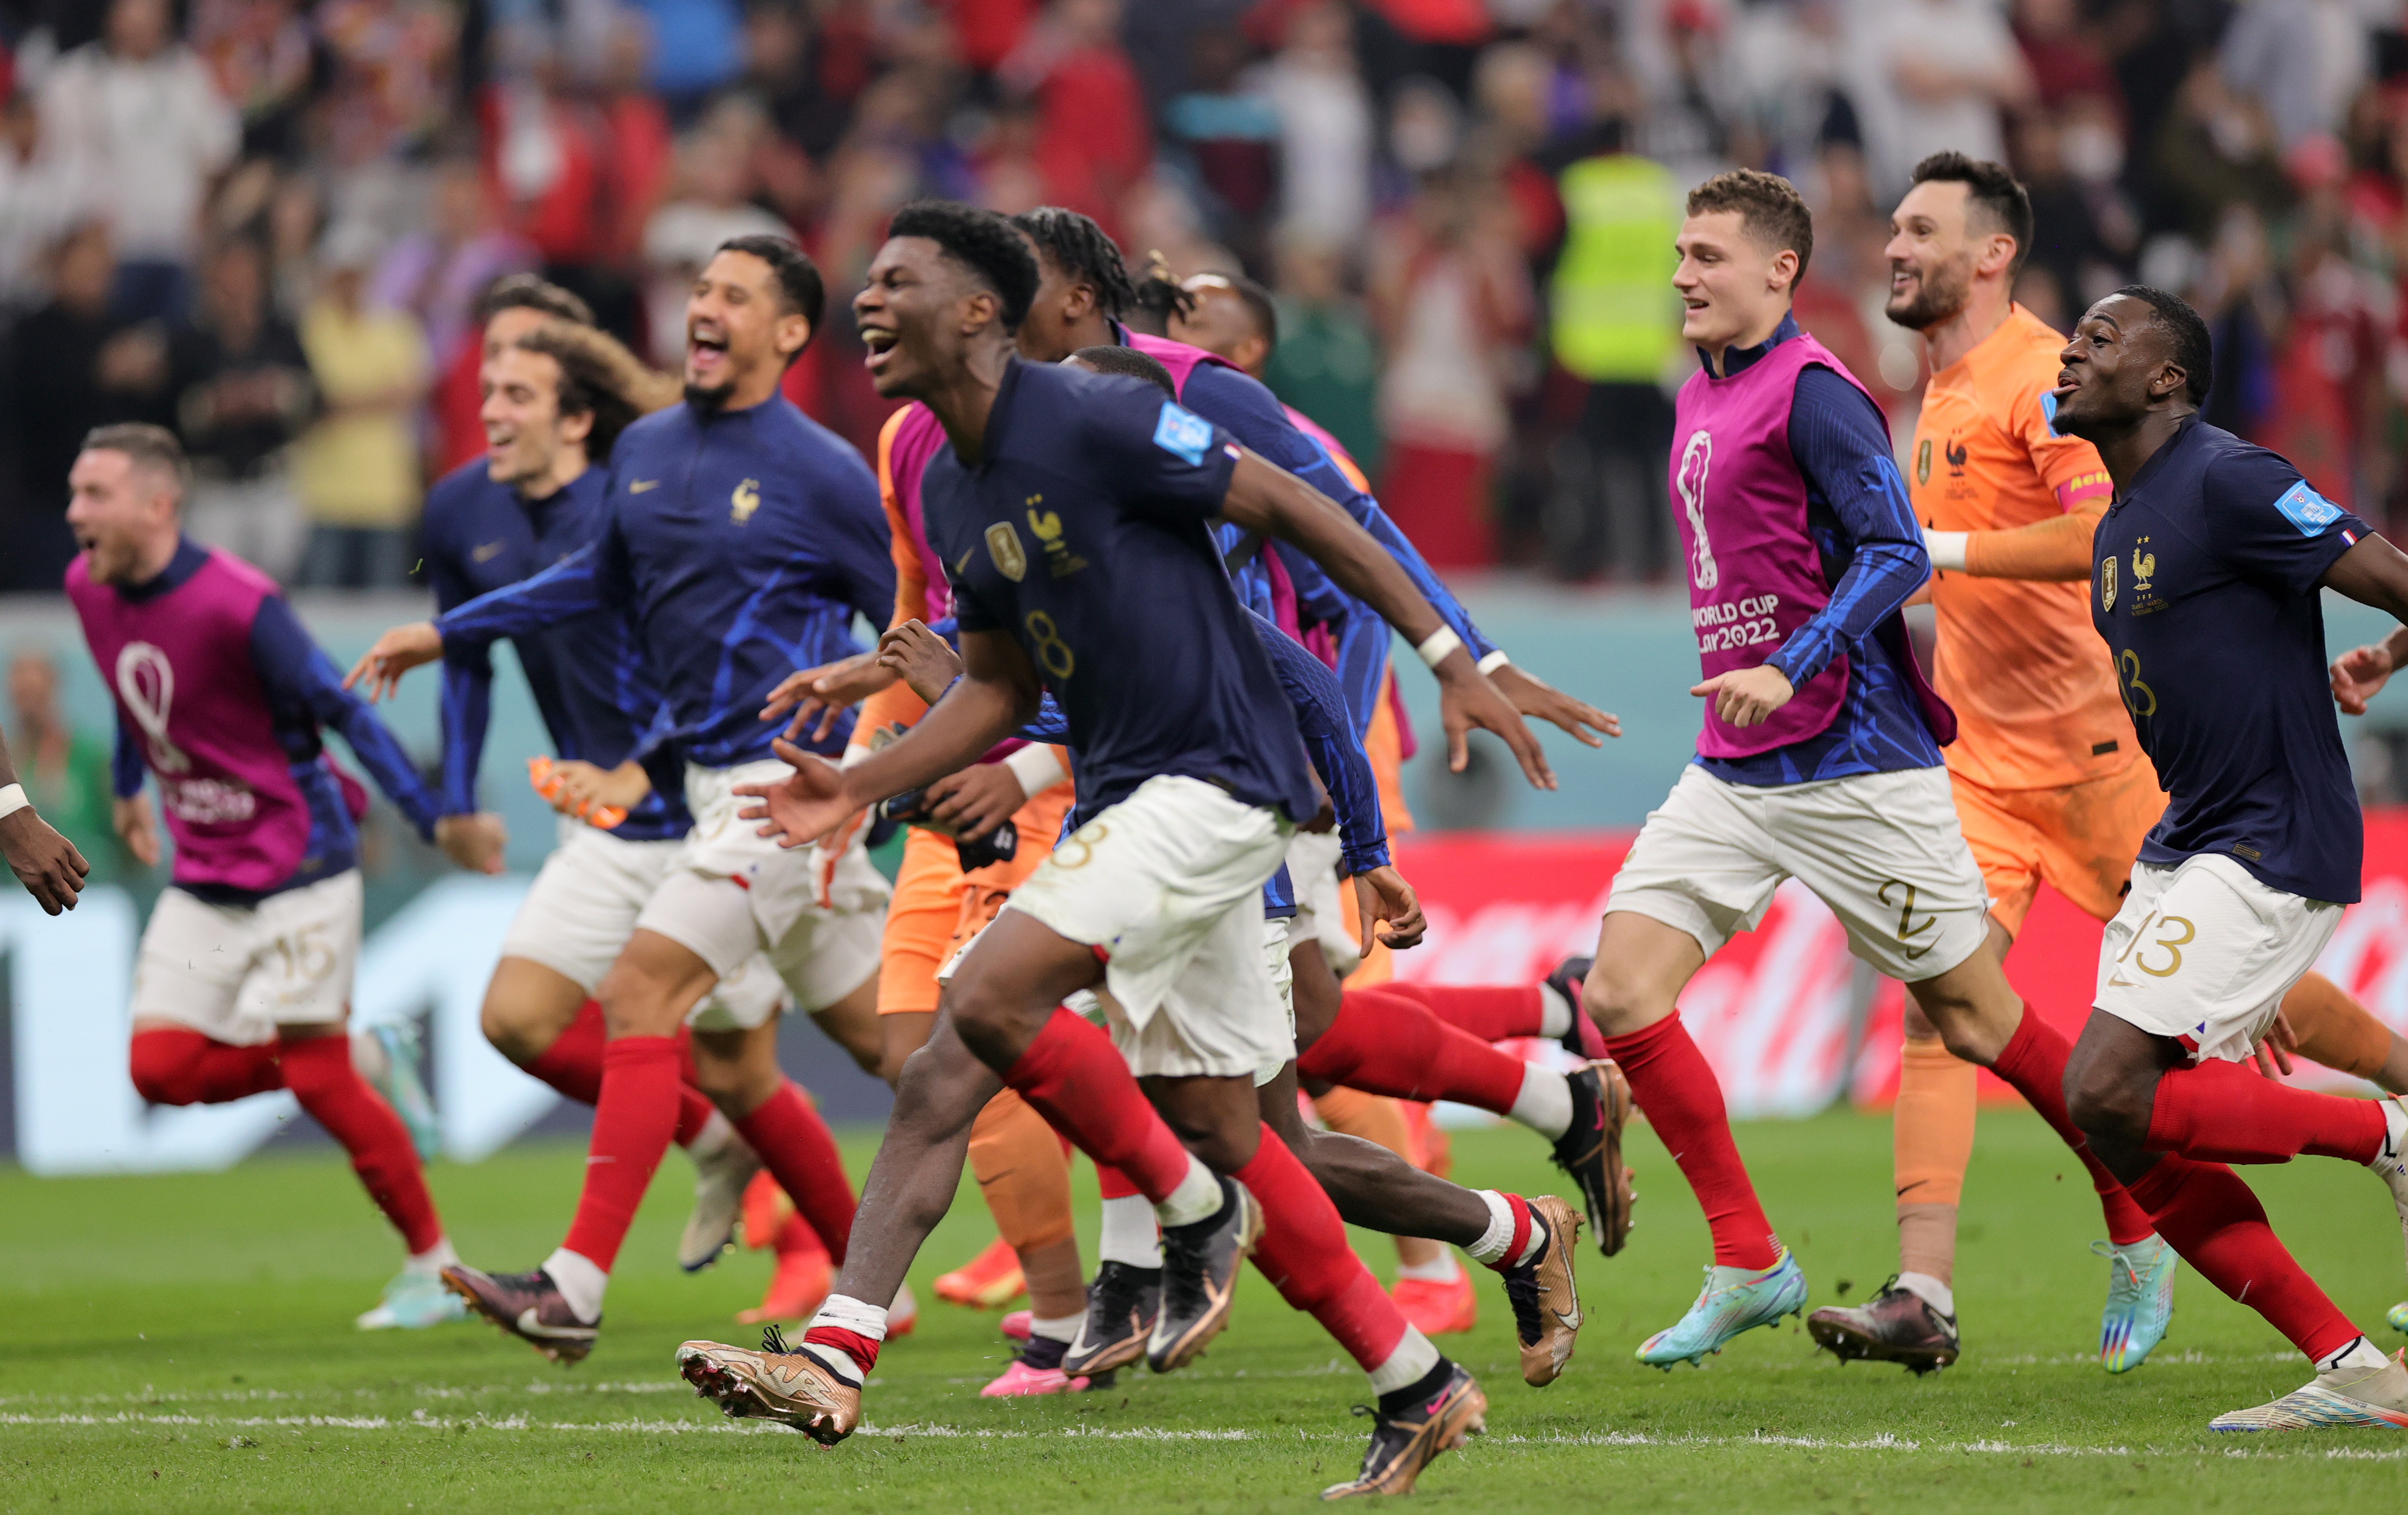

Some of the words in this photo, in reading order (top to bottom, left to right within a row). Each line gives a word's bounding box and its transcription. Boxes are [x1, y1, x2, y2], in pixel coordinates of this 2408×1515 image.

[1740, 594, 1779, 618] CUP
[1026, 610, 1075, 679] 8
[1697, 617, 1780, 654] ar2022
[1049, 824, 1108, 871] 8
[1878, 879, 1937, 940] 2
[2116, 909, 2196, 977] 13
